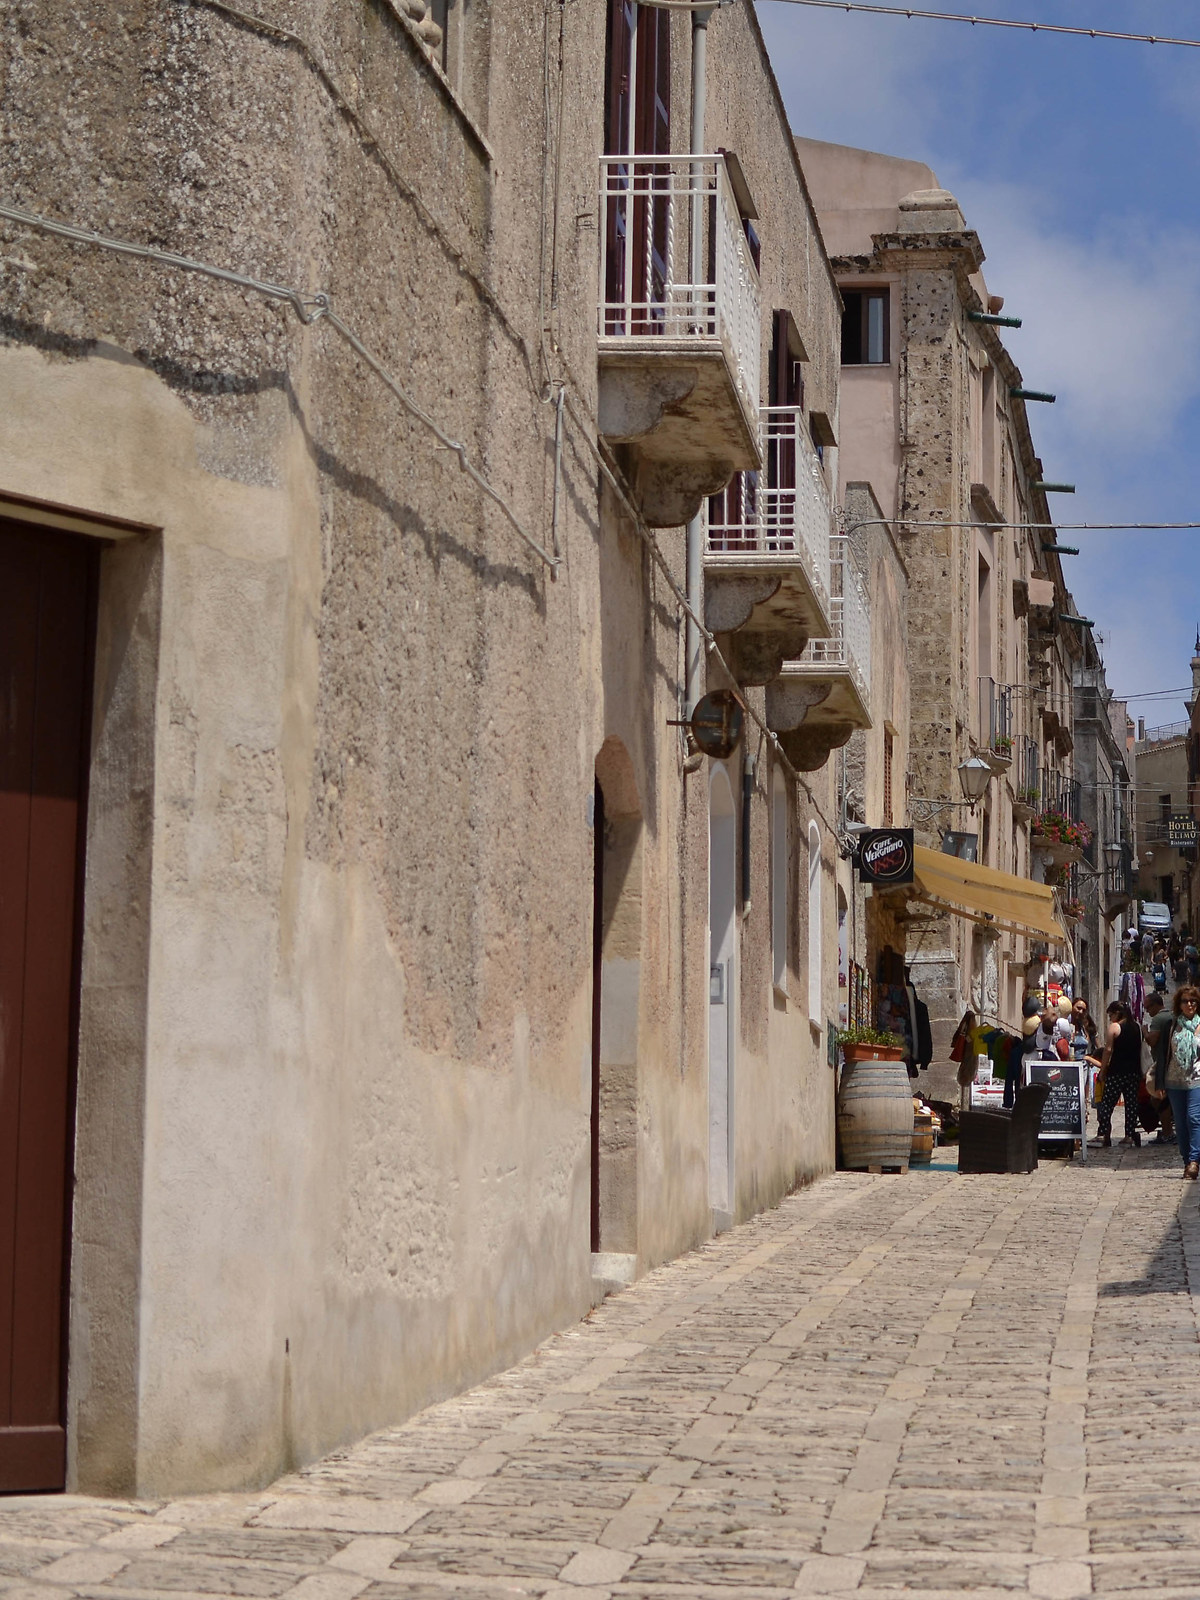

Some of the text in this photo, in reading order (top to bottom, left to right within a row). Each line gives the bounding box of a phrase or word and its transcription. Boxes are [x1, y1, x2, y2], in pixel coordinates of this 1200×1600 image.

[1168, 821, 1197, 830] HOTEL
[1169, 830, 1196, 839] ELIMO
[865, 840, 903, 863] VERGNANO
[1072, 1086, 1079, 1097] 5
